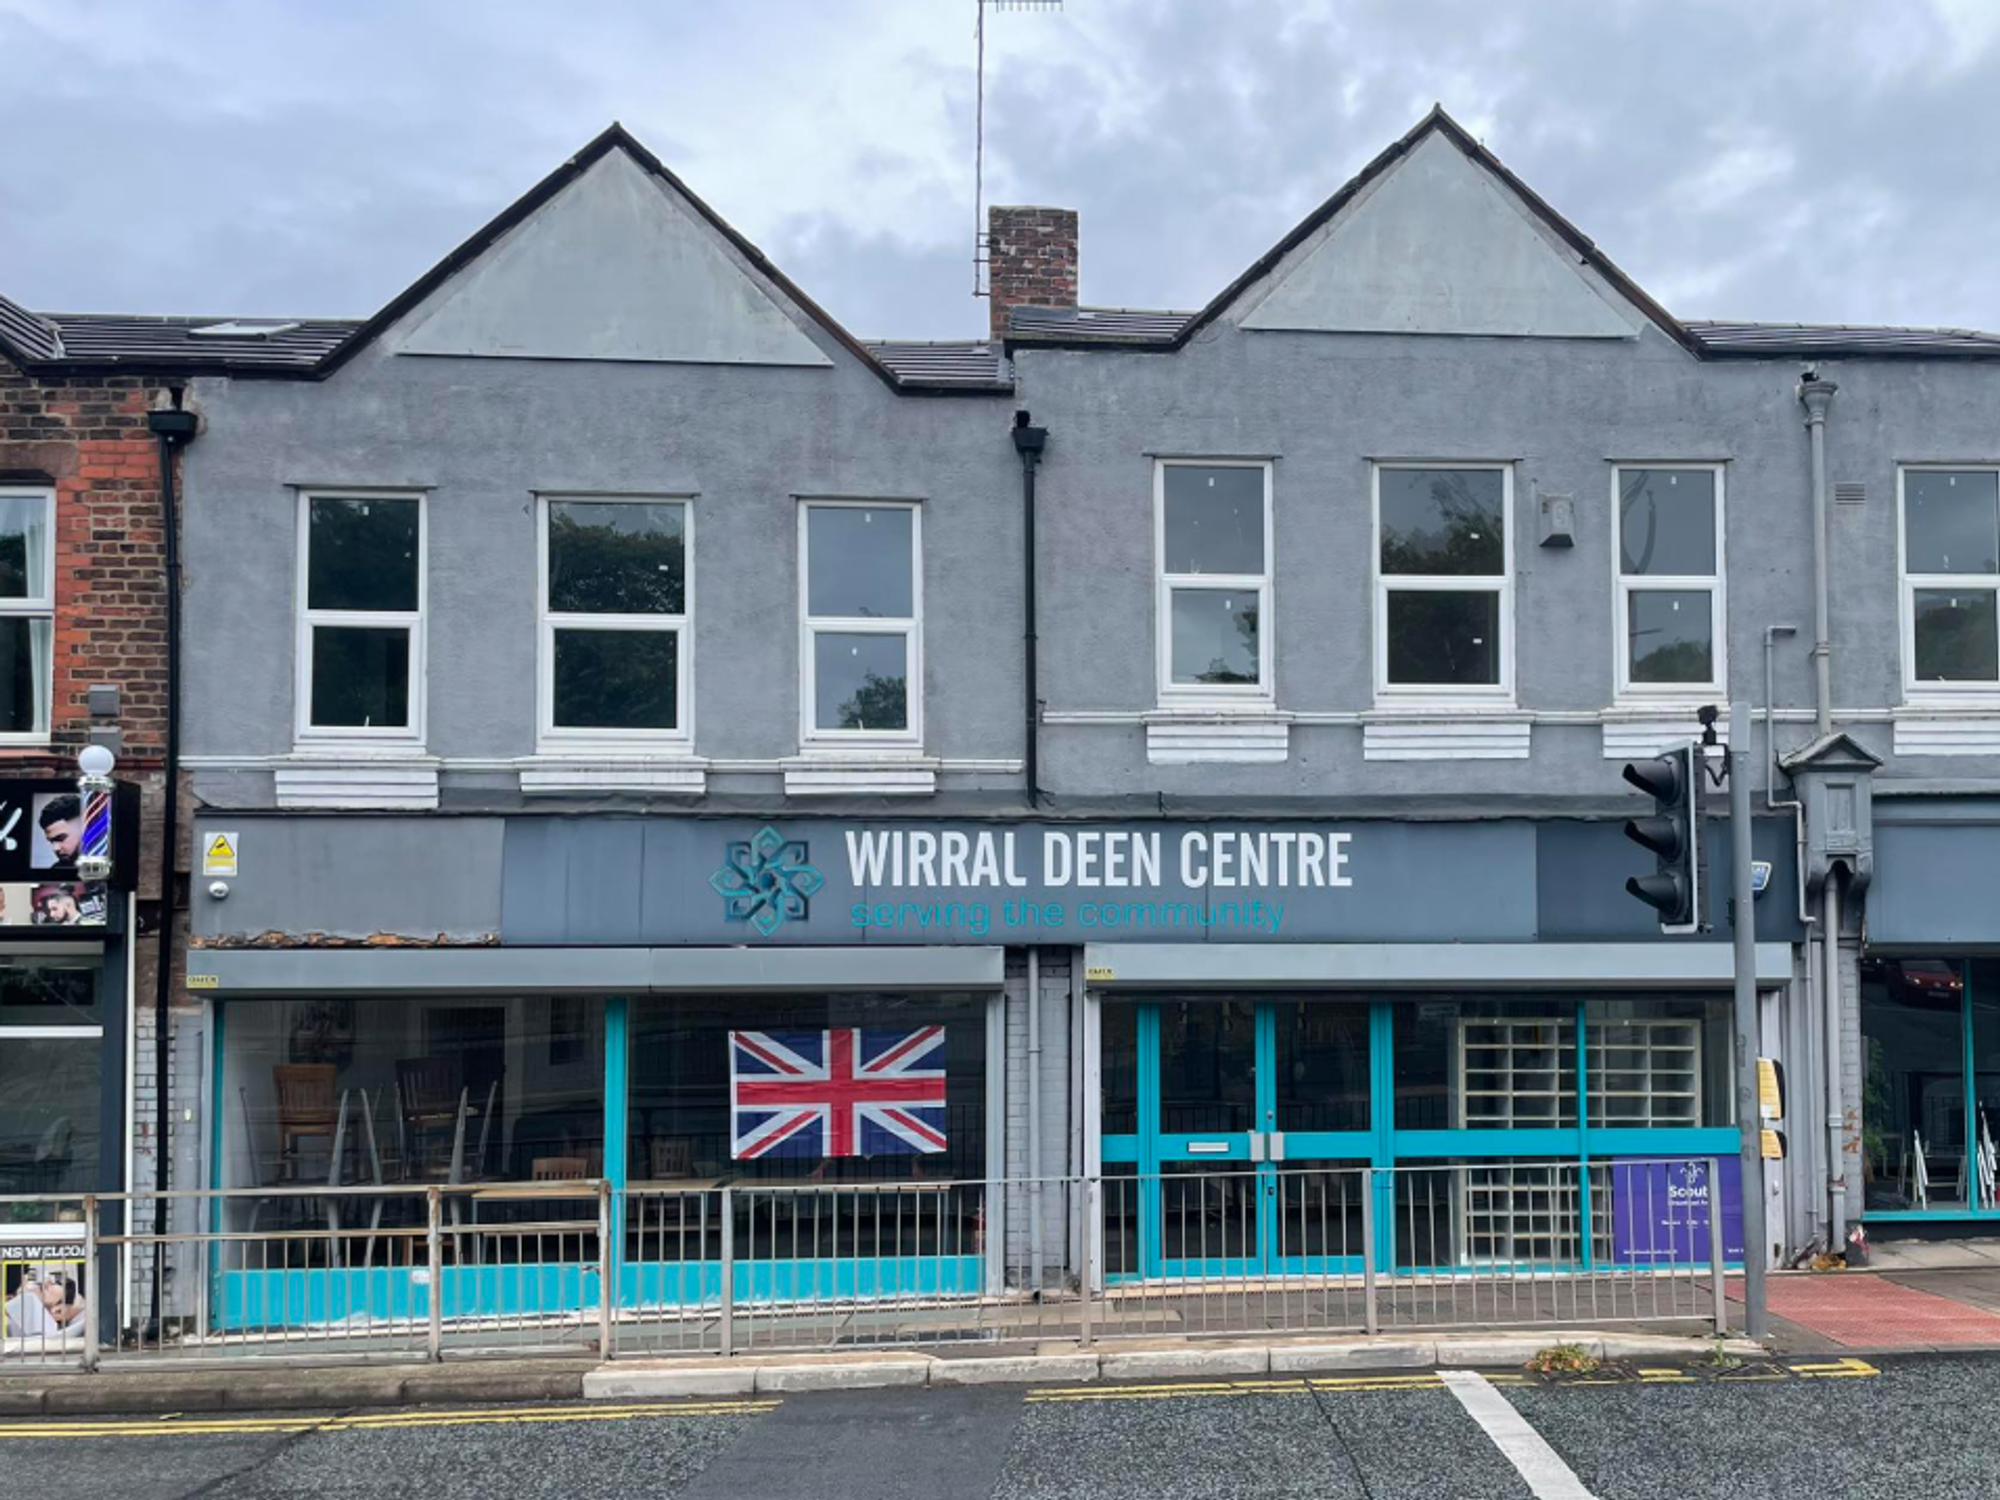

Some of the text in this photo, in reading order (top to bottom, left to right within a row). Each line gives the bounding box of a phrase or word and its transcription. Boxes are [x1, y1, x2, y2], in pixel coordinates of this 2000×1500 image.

[845, 830, 1353, 888] WIRRAL DEEN CENTRE
[851, 895, 1285, 936] serving the community
